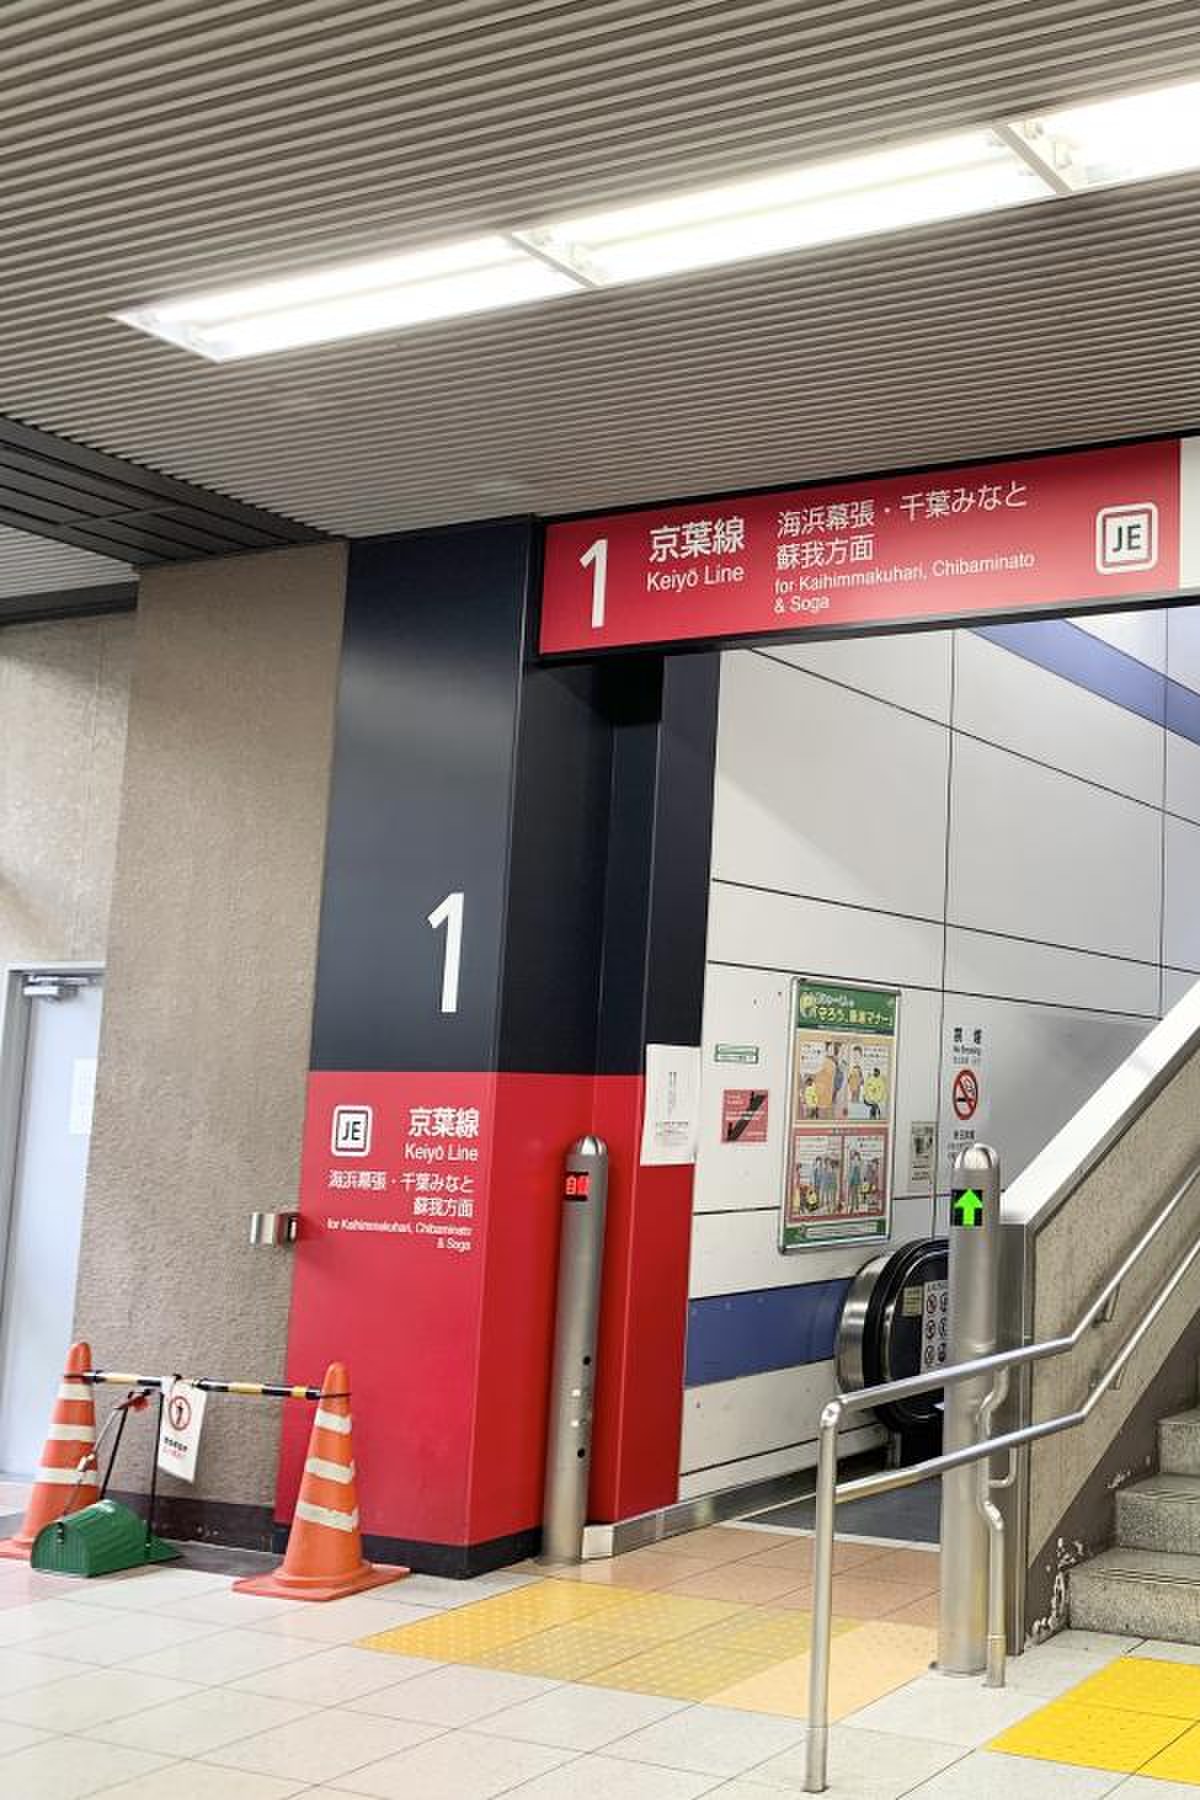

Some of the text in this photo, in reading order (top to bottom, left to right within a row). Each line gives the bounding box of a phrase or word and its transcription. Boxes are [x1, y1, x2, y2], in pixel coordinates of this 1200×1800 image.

[649, 516, 746, 563] 京葉線
[776, 533, 875, 572] 蘇我方面
[1112, 523, 1141, 552] JE
[579, 538, 609, 629] 1
[704, 564, 745, 585] Line
[775, 552, 1035, 594] for Kaihimmakuhari, Chibaminato
[773, 594, 831, 614] & Soga
[427, 891, 466, 1013] 1
[342, 1121, 362, 1141] JE
[408, 1107, 480, 1139] 京葉線
[447, 1144, 479, 1162] Line
